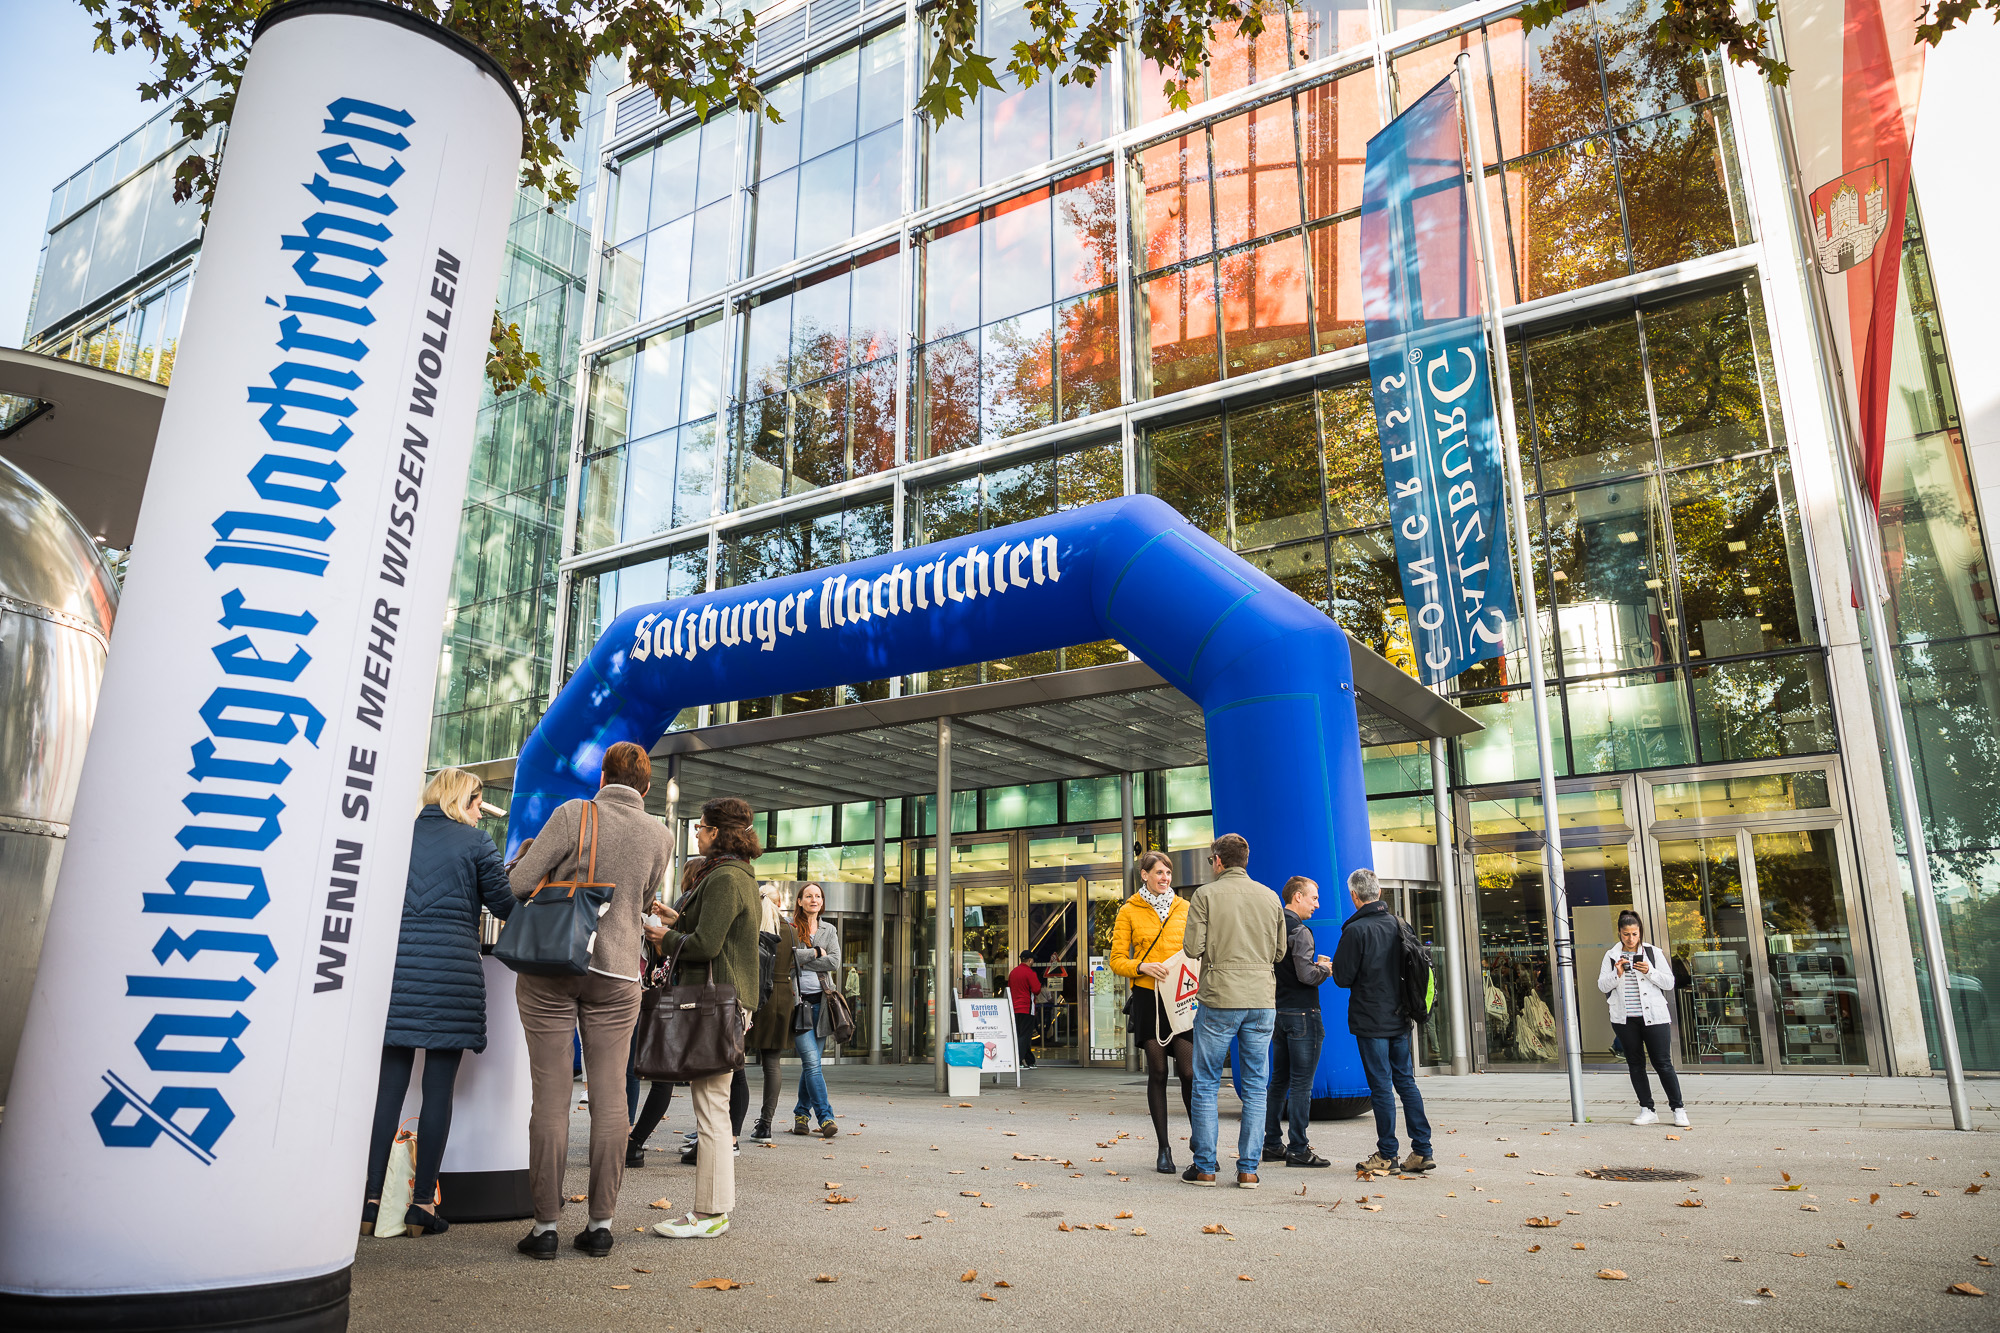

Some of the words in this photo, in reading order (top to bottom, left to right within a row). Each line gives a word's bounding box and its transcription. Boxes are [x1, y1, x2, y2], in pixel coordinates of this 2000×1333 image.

[204, 97, 416, 578] Nachrichten
[409, 247, 461, 418] WOLLEN
[379, 422, 429, 587] WISSEN
[356, 598, 401, 732] MEHR
[629, 588, 814, 663] Salzburger
[819, 534, 1061, 630] Nachrichten
[341, 745, 378, 822] SIE
[91, 587, 327, 1166] Salzburger
[313, 839, 364, 994] WENN
